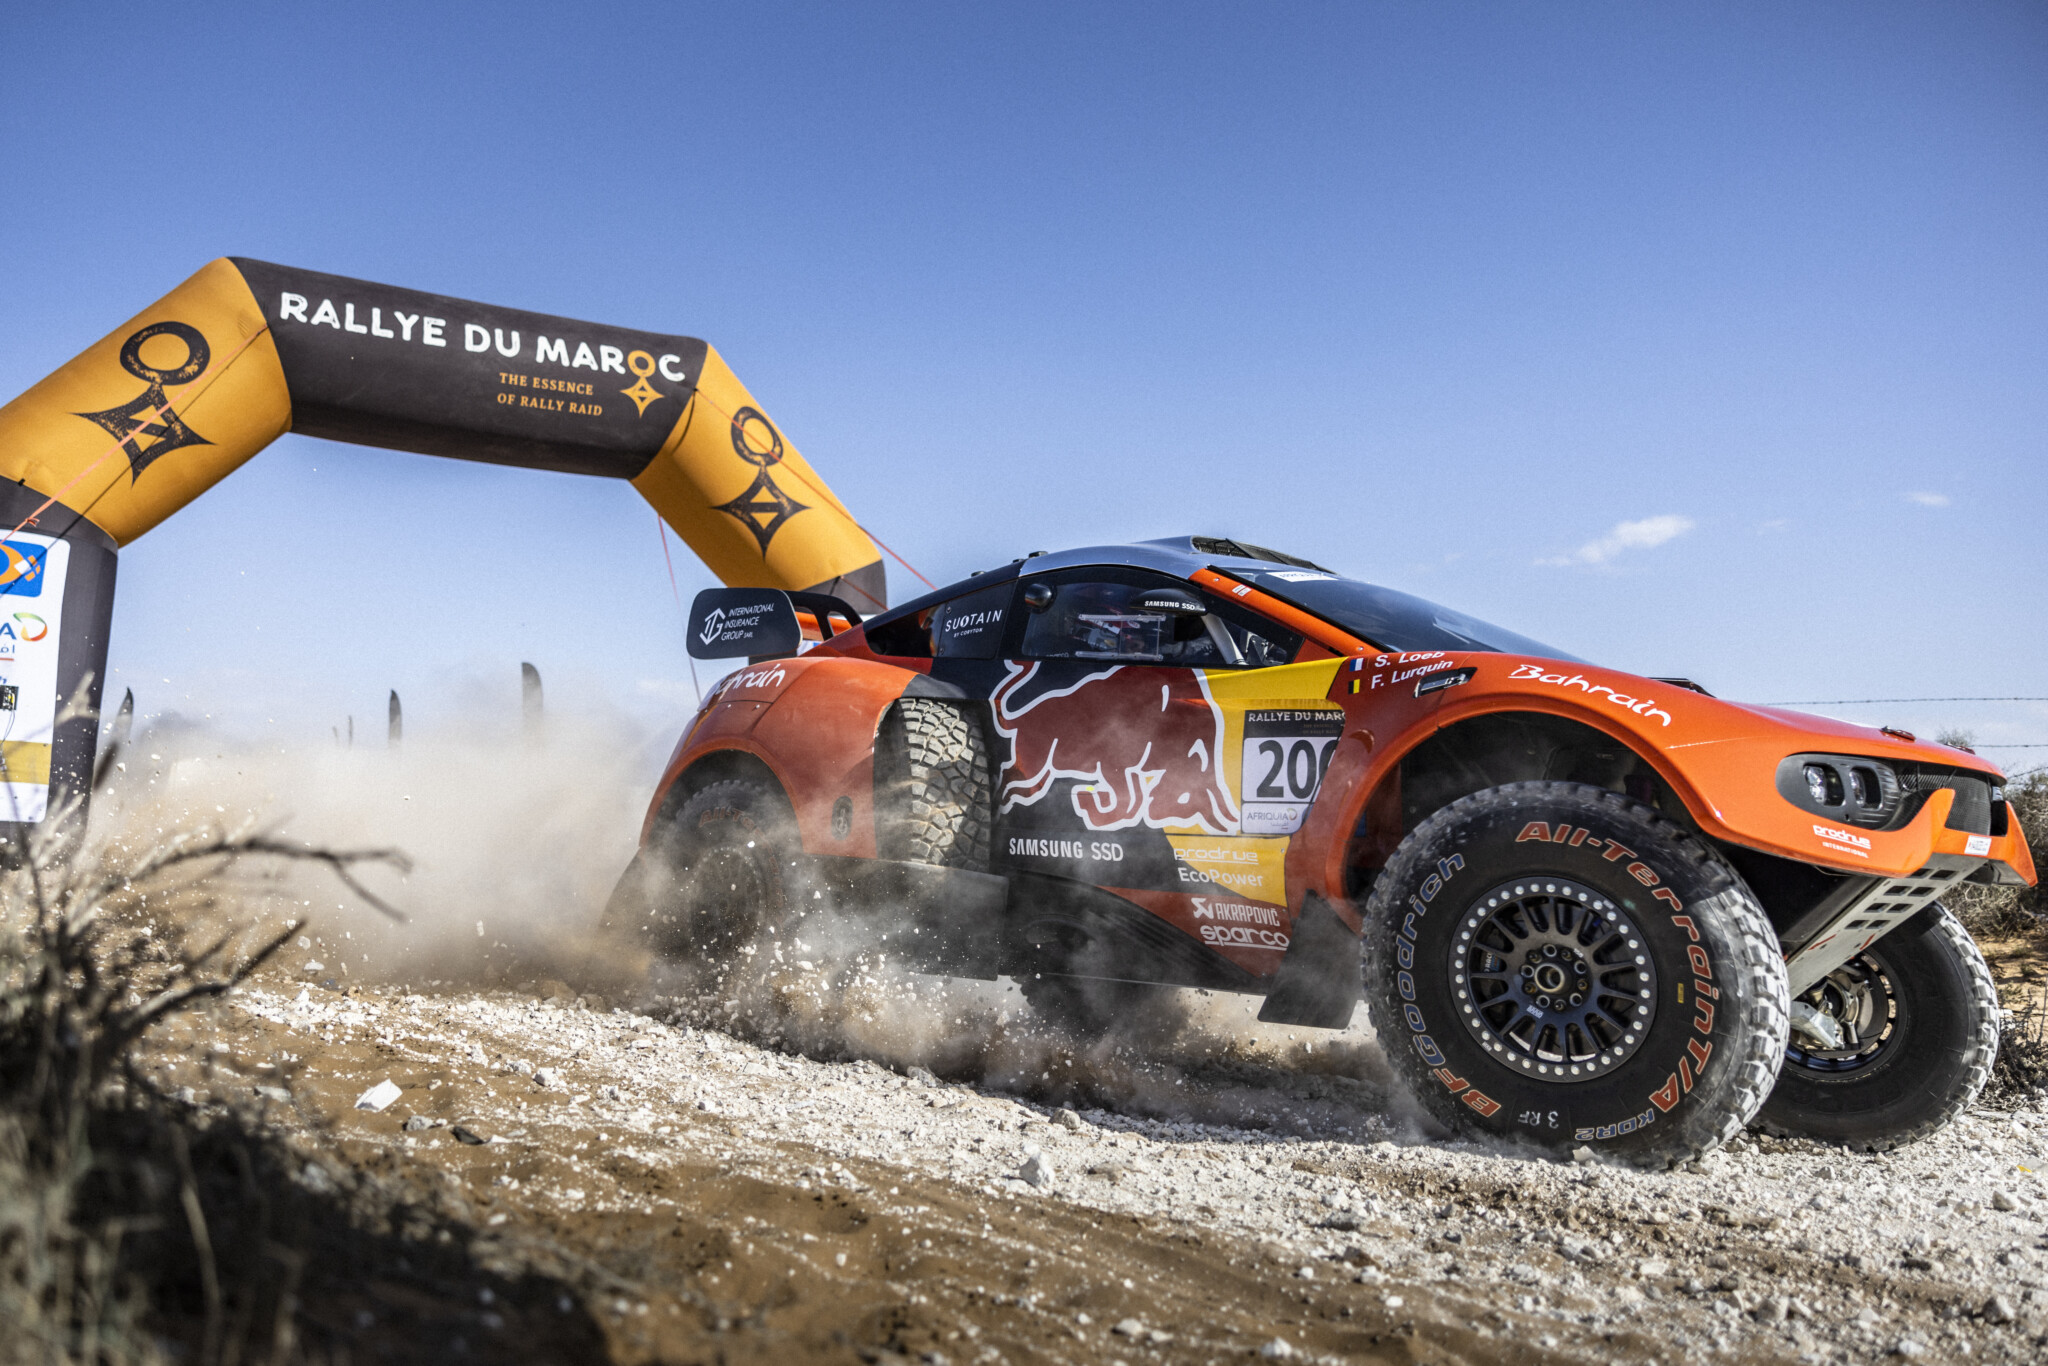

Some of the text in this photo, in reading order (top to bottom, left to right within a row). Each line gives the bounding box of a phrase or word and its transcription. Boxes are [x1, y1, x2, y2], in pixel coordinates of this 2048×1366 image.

[280, 291, 685, 383] RALLYE DU MAROC
[500, 372, 594, 396] THE ESSENCE
[497, 393, 603, 416] OF RALLY RAID
[728, 602, 775, 617] INTERNATIONAL
[1144, 600, 1196, 611] SAMSUNG SSD
[724, 616, 760, 629] INSURANCE
[721, 629, 745, 641] GROUP
[1374, 650, 1446, 669] S. Loeb
[713, 663, 786, 695] ahrain
[1370, 658, 1454, 690] F. Lurquin
[1508, 664, 1672, 728] Bahrain
[1248, 711, 1291, 722] RALLYE
[1294, 711, 1311, 721] DU
[1247, 811, 1289, 821] AFRIQUIA
[1008, 838, 1124, 862] SAMSUNG SSD
[1173, 846, 1258, 863] prodrive
[1177, 867, 1264, 887] EcoPower
[1215, 902, 1281, 928] AKRAPOVIČ
[1200, 924, 1290, 948] sparco
[1397, 853, 1502, 1117] BFGoodrich
[1518, 1110, 1559, 1129] 3 RF
[1574, 1108, 1656, 1140] KDR2
